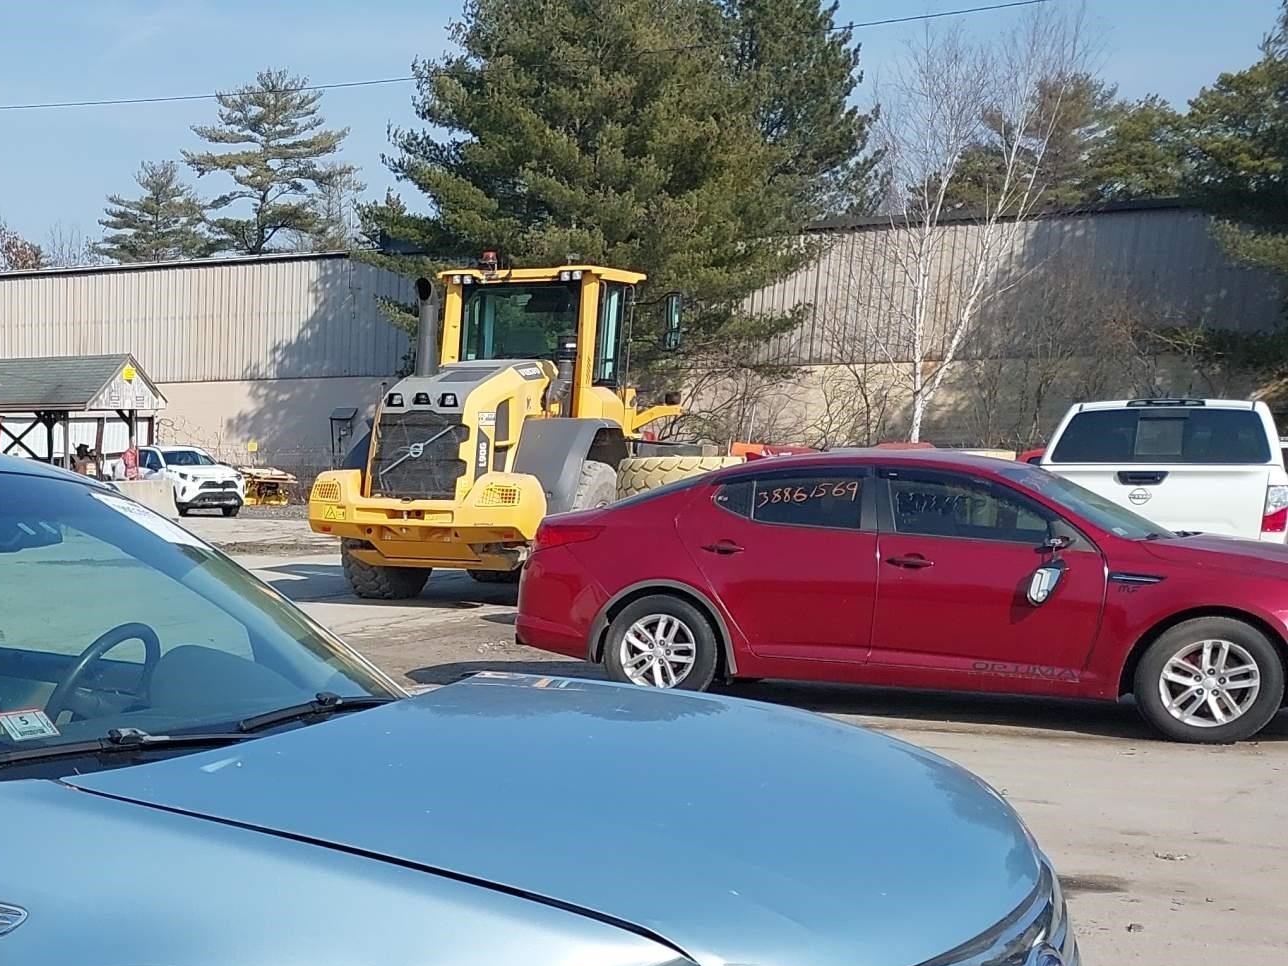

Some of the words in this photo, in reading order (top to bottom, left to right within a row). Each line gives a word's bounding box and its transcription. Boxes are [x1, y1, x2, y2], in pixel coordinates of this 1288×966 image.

[757, 481, 859, 508] 38861569
[972, 661, 1079, 681] OPTIMA
[19, 716, 29, 725] 5
